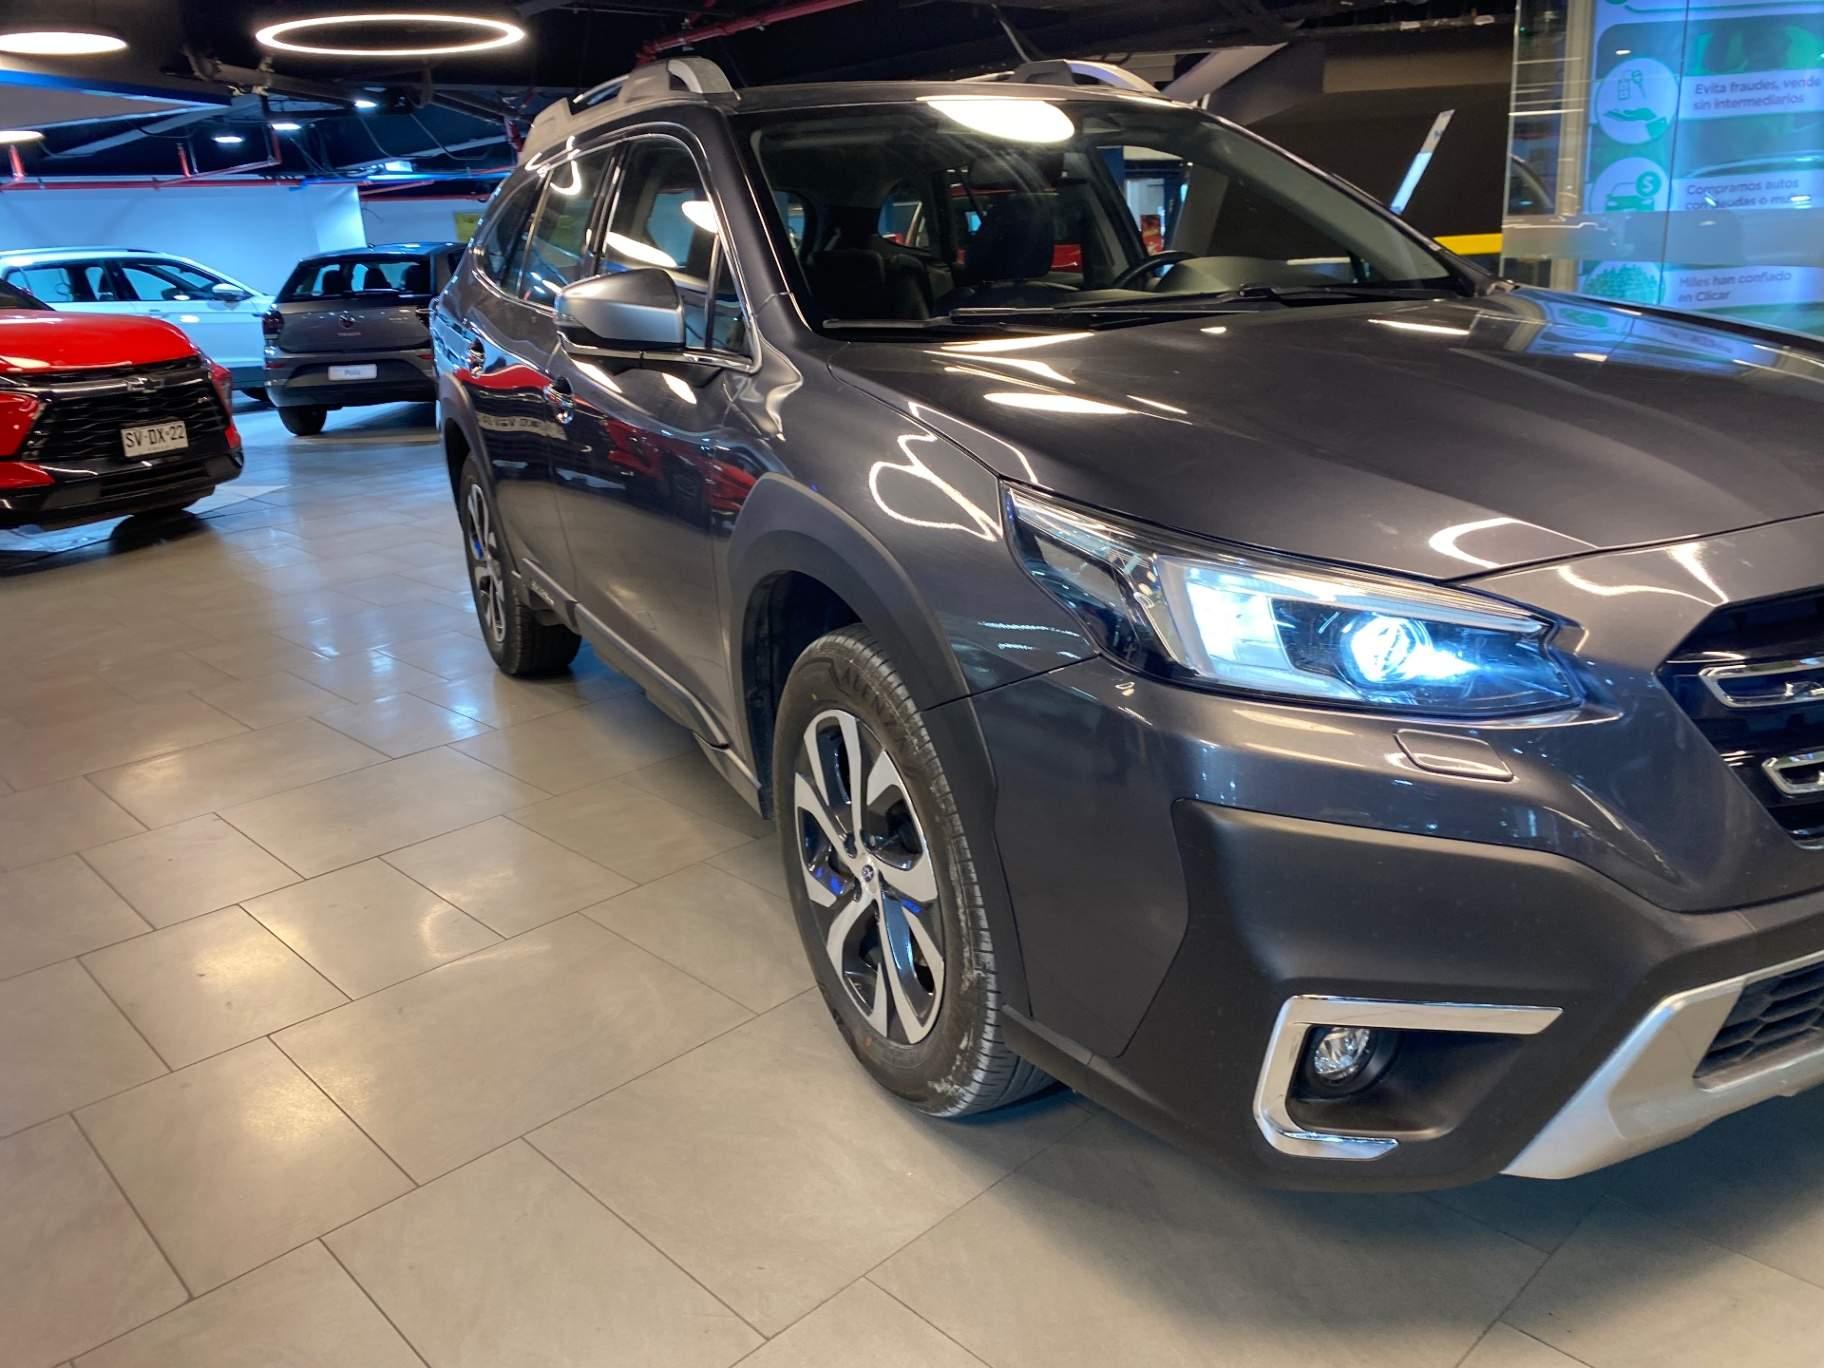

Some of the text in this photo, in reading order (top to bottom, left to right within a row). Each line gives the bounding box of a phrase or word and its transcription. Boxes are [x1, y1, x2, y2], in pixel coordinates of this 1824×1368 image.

[1695, 83, 1727, 95] Evita
[1687, 178, 1799, 195] Compramos autos
[1712, 274, 1736, 286] han
[1737, 271, 1792, 284] confiado
